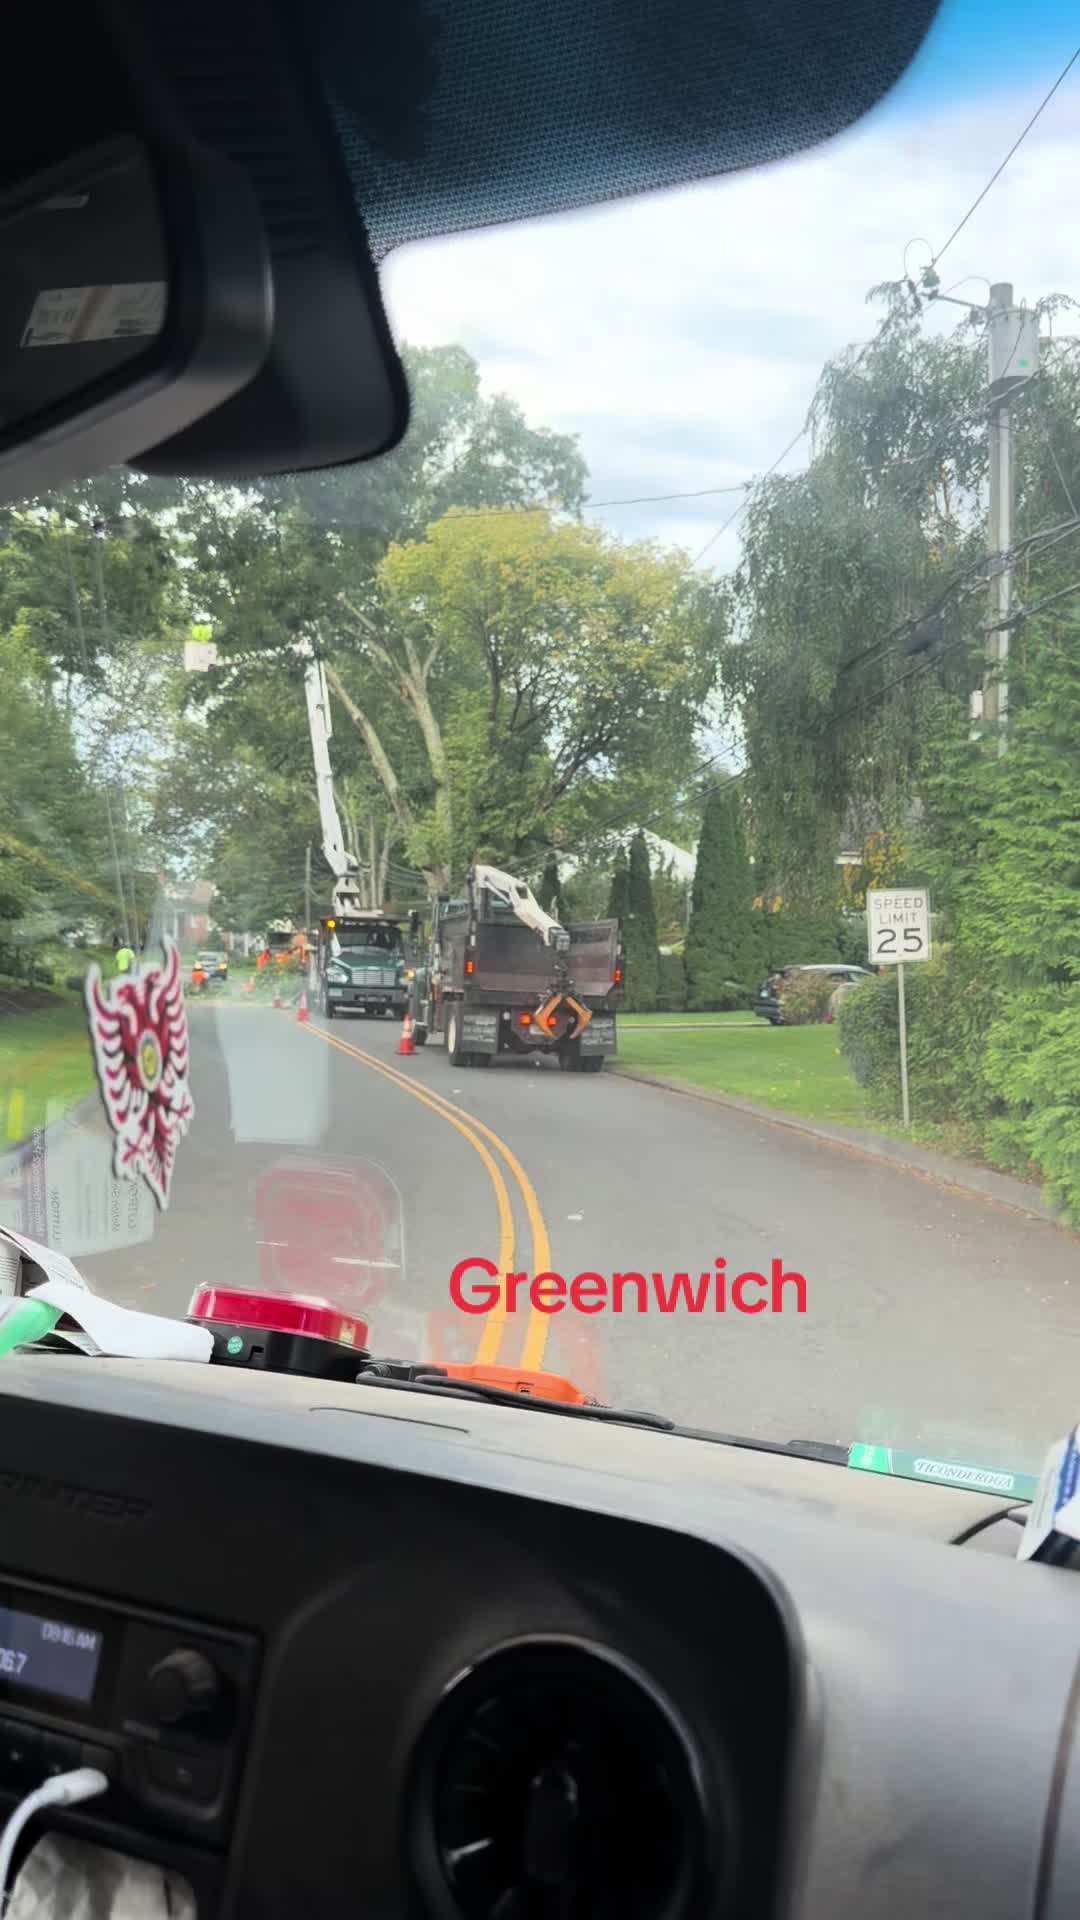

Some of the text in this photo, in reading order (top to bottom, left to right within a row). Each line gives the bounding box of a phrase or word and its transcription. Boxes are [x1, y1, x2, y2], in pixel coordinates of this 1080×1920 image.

[873, 897, 924, 910] SPEED
[879, 912, 918, 925] LIMIT
[876, 928, 923, 954] 25
[917, 1462, 1011, 1489] TICONDEROGA
